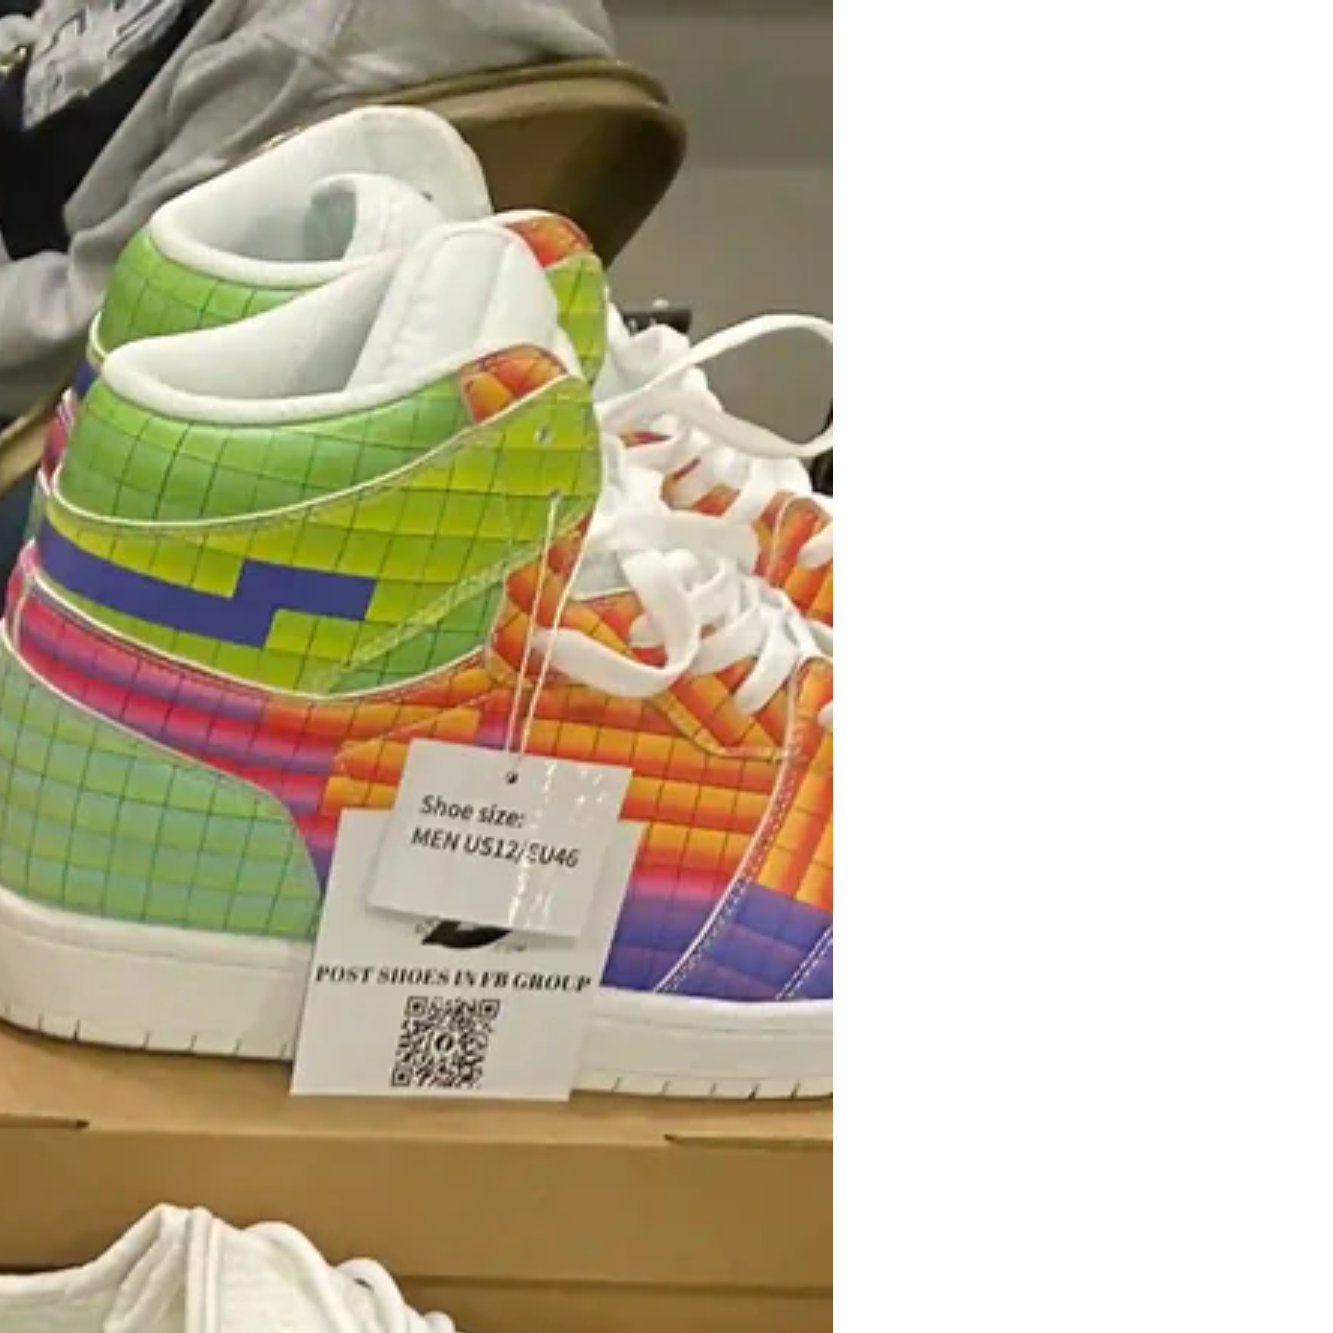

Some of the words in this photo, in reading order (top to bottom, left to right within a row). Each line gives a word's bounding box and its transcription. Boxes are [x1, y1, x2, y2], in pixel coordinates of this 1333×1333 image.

[419, 794, 474, 822] Shoe
[478, 803, 526, 829] size:
[410, 826, 460, 852] MEN
[315, 964, 371, 984] POST
[376, 966, 451, 986] SHOES
[454, 969, 477, 987] IN
[480, 970, 510, 989] FB
[512, 973, 593, 993] GROUP
